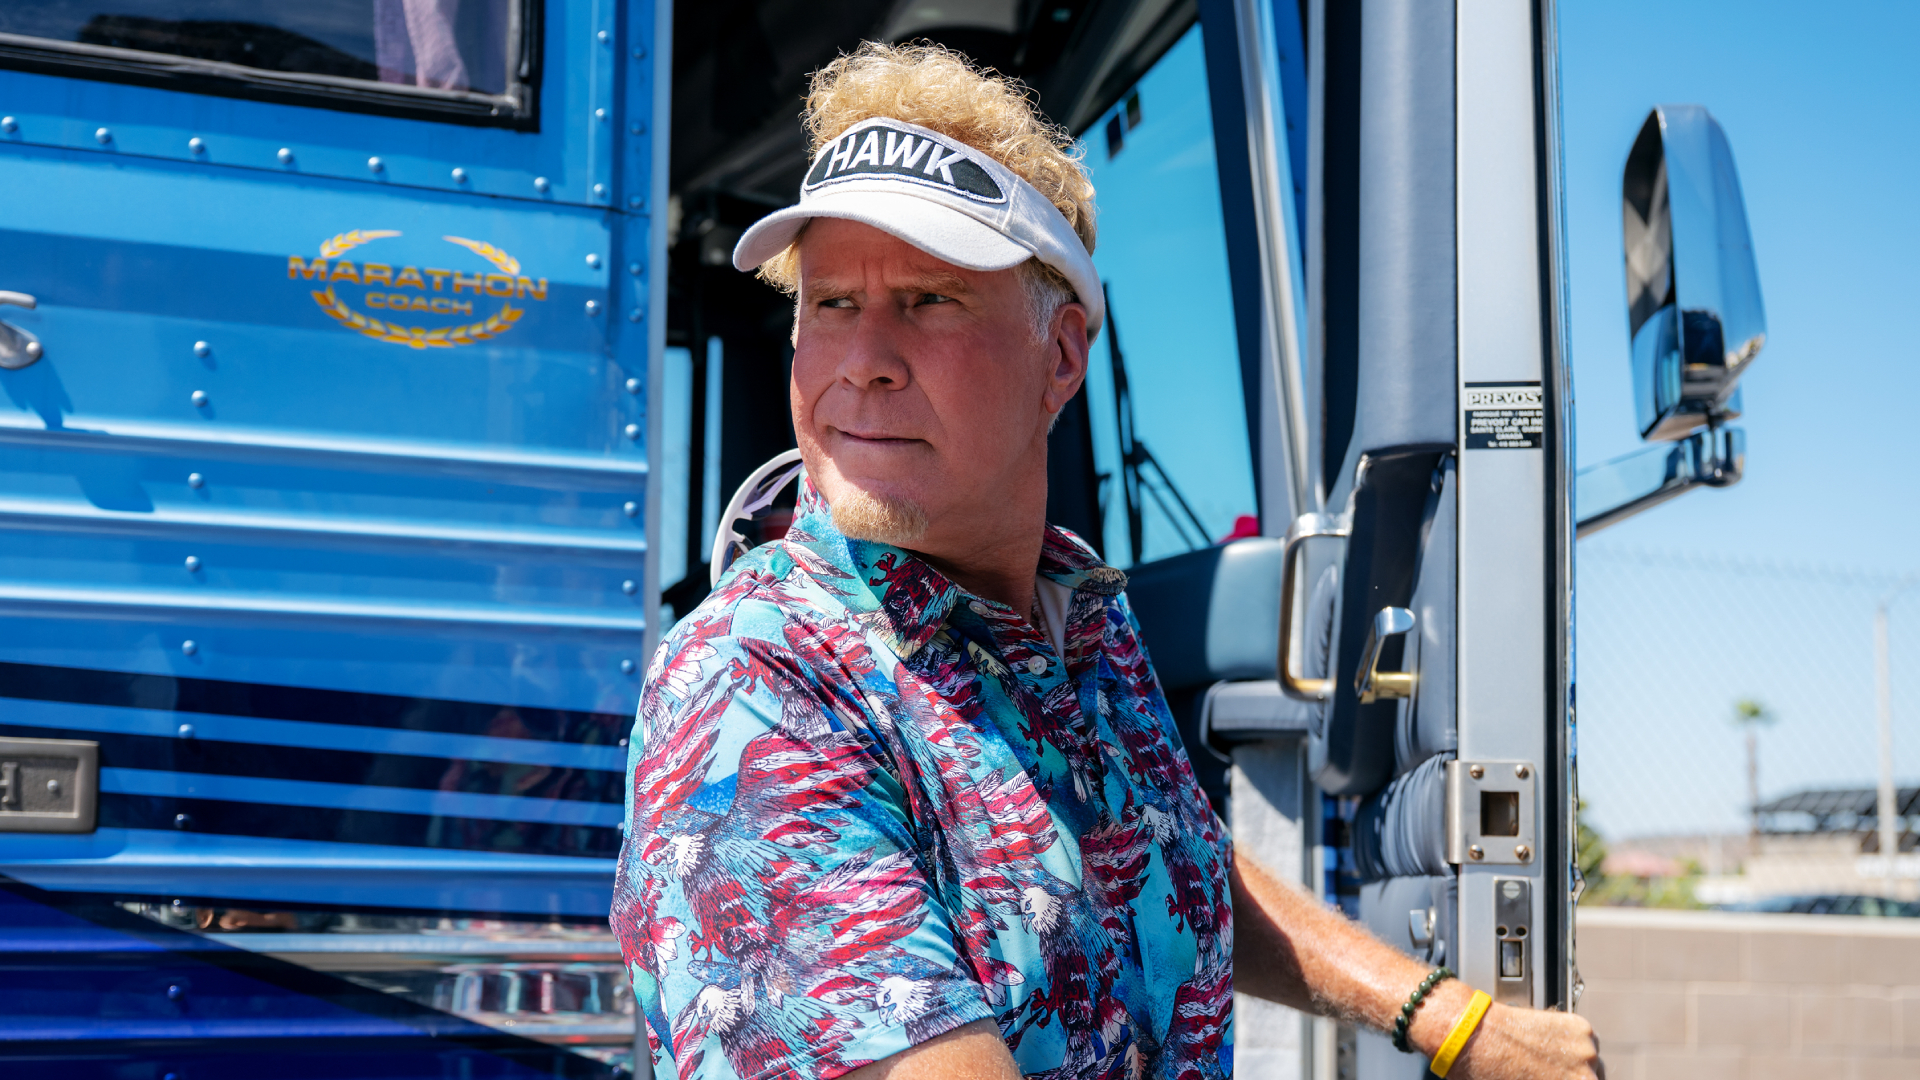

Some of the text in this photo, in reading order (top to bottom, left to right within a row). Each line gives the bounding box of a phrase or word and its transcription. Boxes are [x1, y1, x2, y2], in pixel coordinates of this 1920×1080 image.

[823, 130, 967, 185] HAWK
[288, 256, 548, 300] MARATHON
[365, 292, 473, 316] COACH
[1471, 418, 1510, 427] PREVOST
[1511, 418, 1529, 426] CAR
